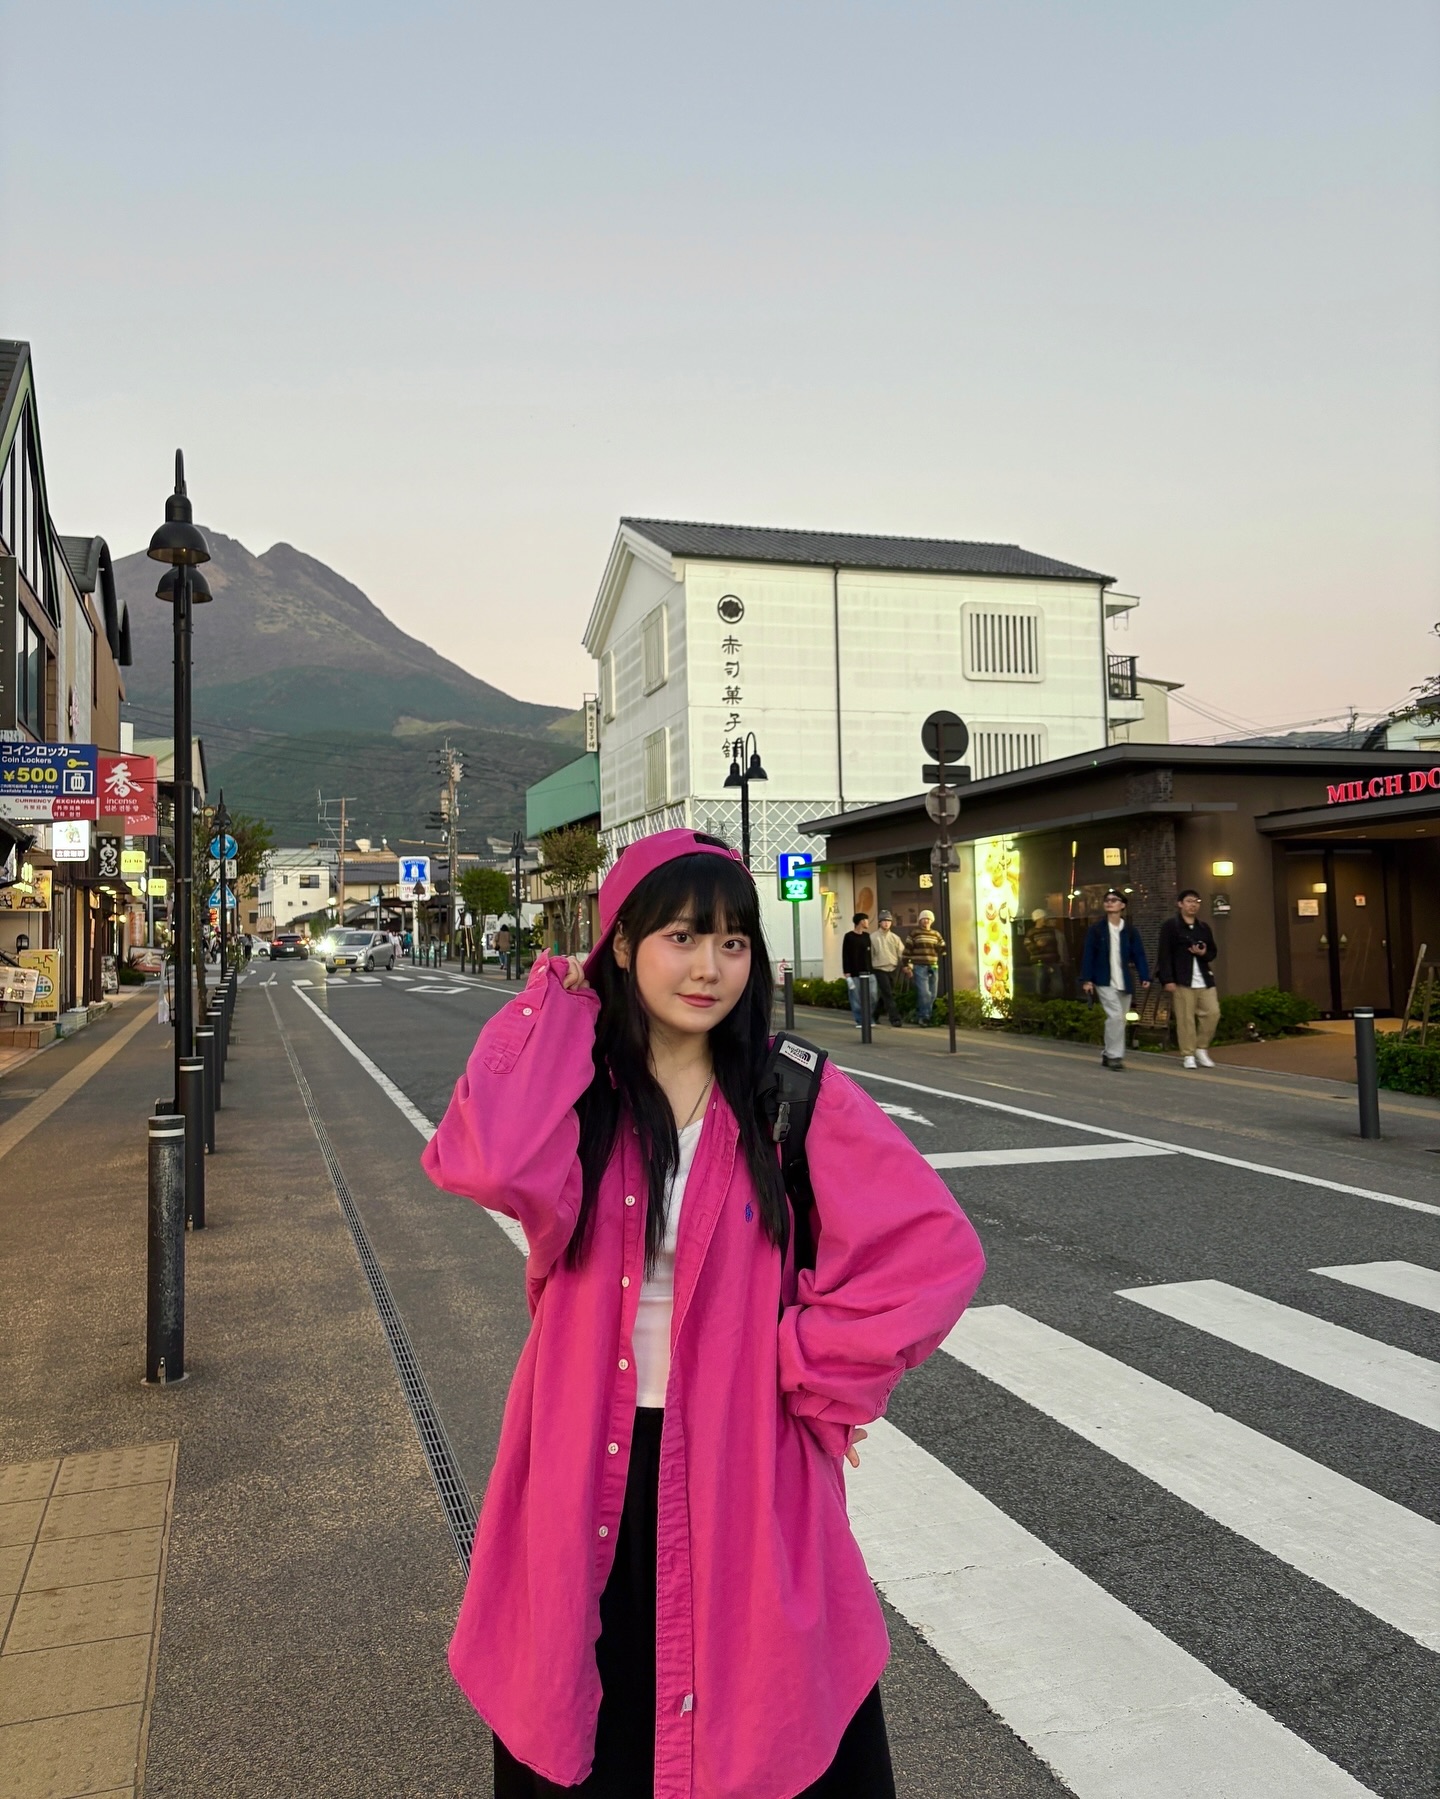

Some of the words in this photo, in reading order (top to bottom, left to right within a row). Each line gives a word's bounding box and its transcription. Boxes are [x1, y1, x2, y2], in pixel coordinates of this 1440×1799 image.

[2, 745, 80, 757] コインロッカー
[3, 767, 58, 783] ¥500
[104, 761, 144, 798] 香
[1326, 774, 1404, 804] MILCH
[106, 797, 137, 805] incense
[788, 856, 806, 876] P
[785, 879, 808, 899] 空
